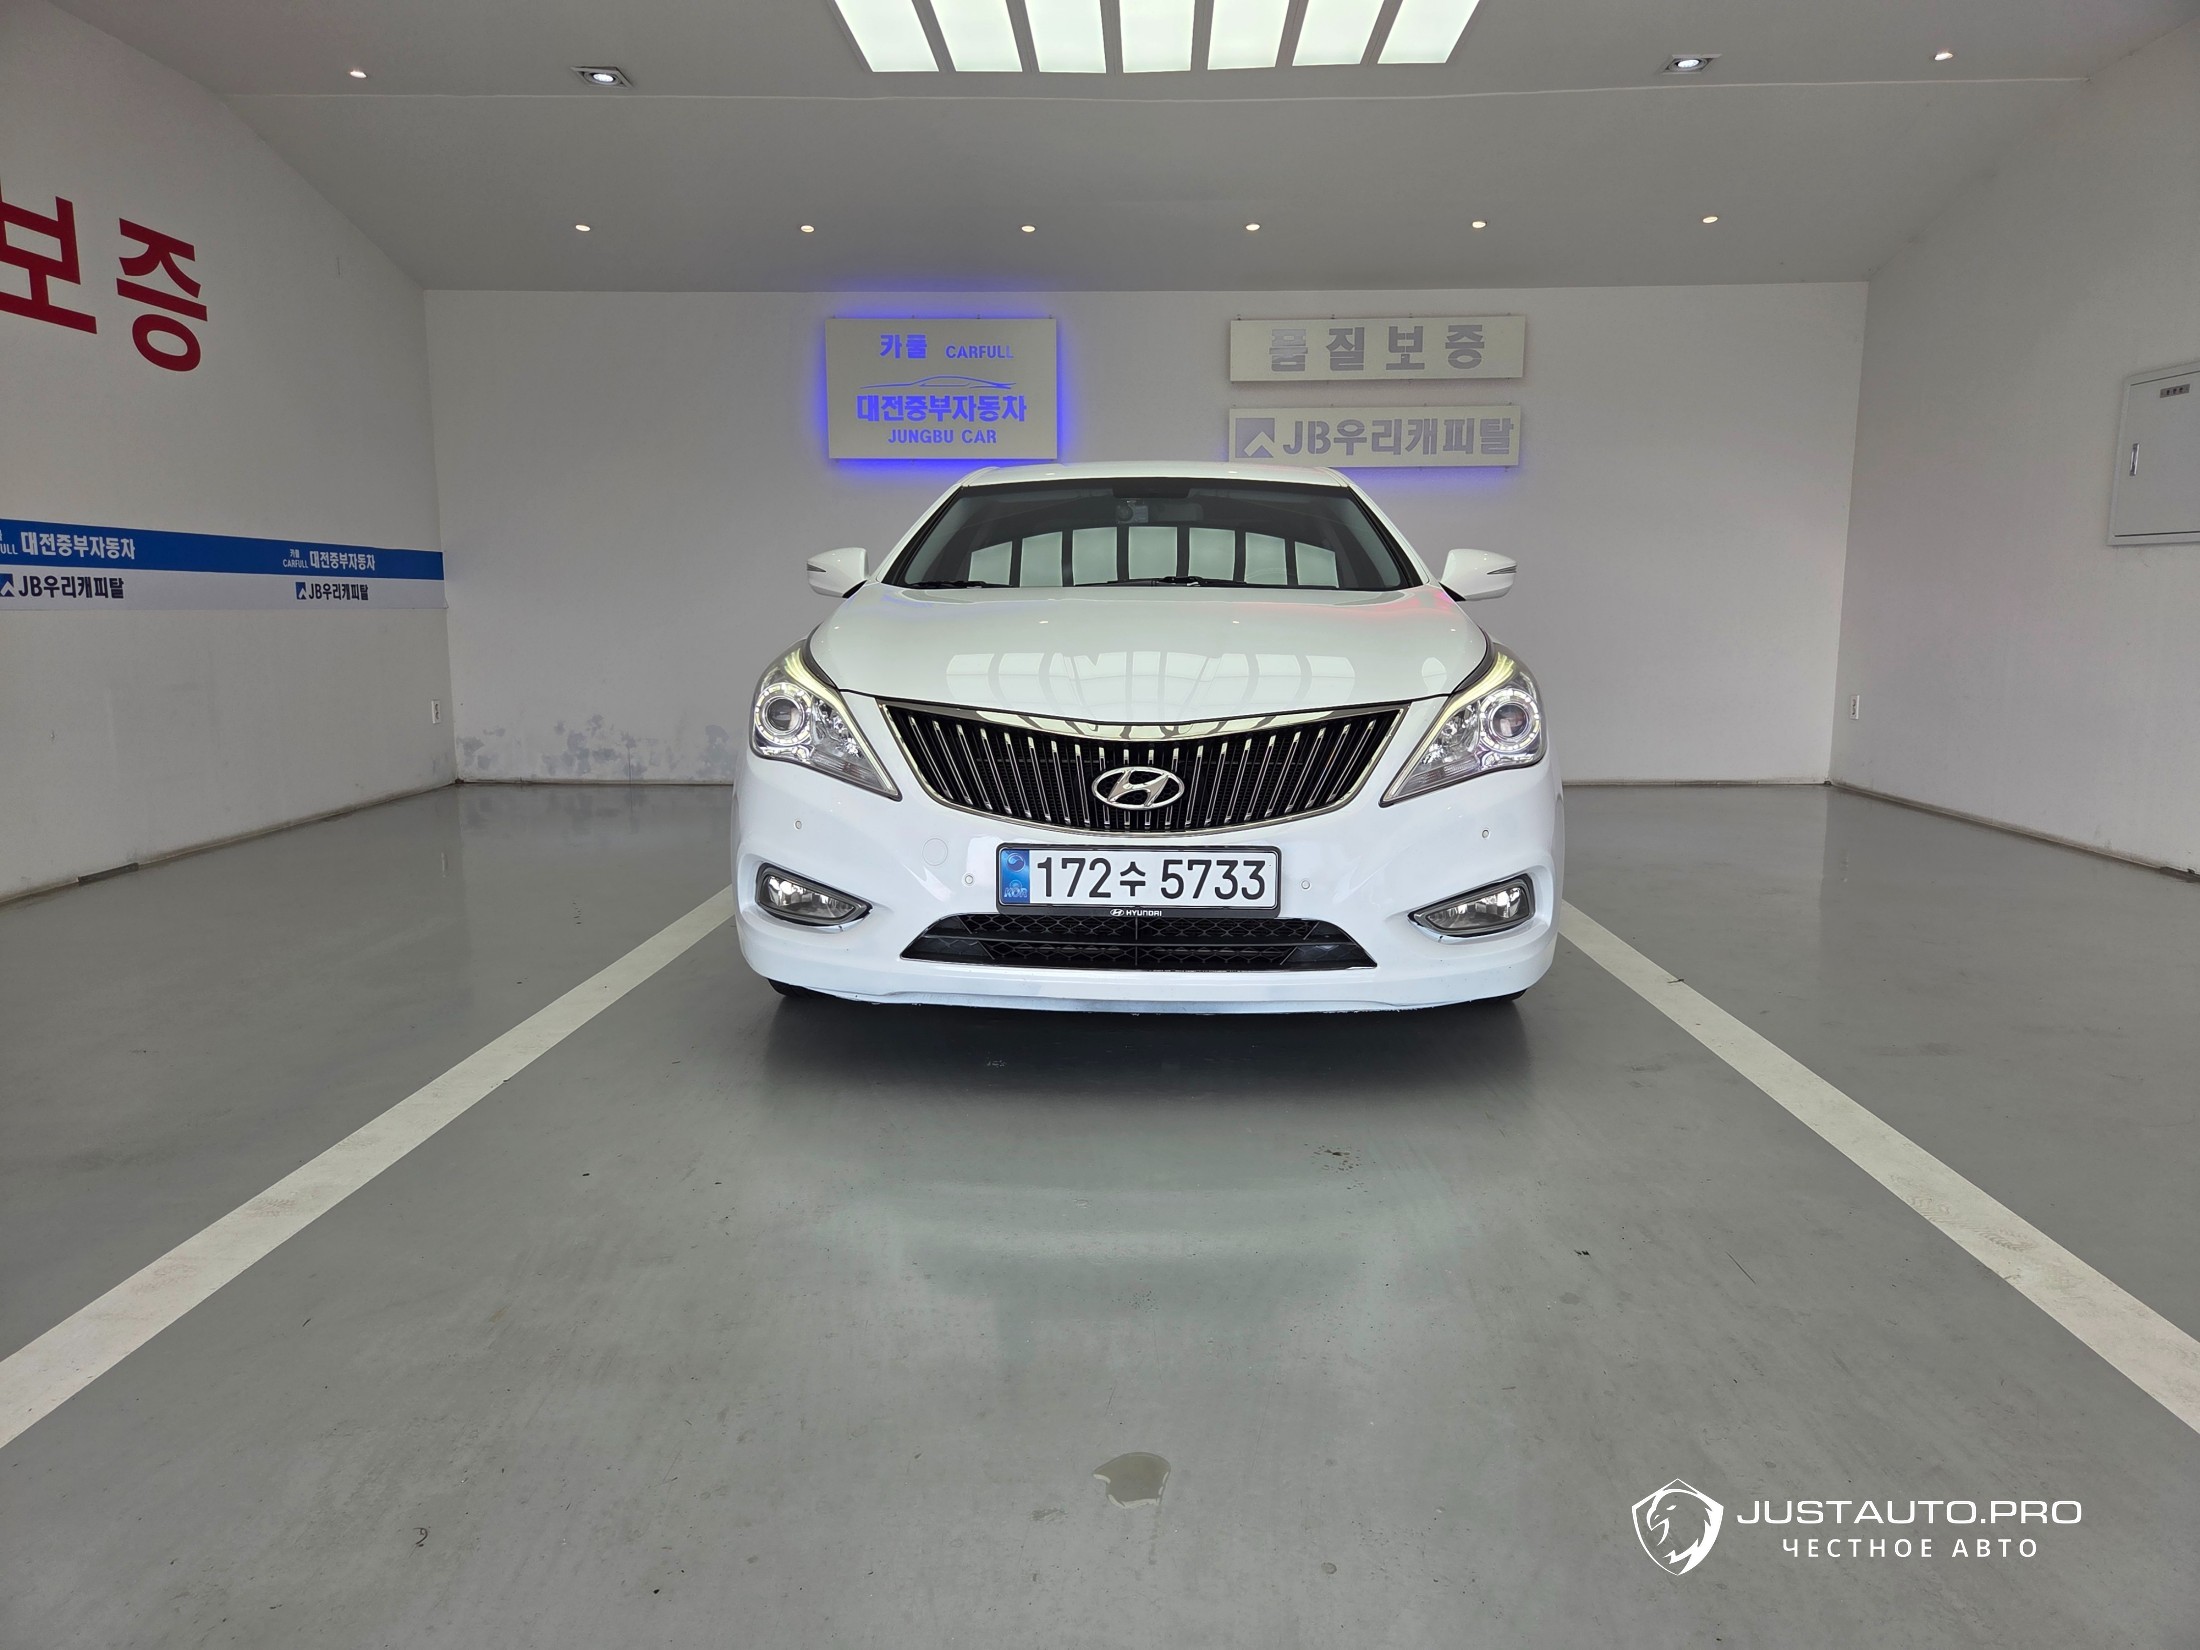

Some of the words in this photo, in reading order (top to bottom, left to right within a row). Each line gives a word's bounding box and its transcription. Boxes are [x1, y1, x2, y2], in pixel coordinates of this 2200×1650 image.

[945, 345, 1014, 359] CARFULL
[857, 395, 1027, 422] 대전중부자동차
[888, 429, 954, 444] JUNGBU
[961, 429, 997, 444] CAR
[1282, 417, 1514, 456] JB우리캐피탈
[20, 531, 136, 560] 대전중부자동차
[282, 559, 309, 569] CARFULL
[309, 550, 376, 571] 대전중부자동차
[18, 575, 124, 599] JB우리캐피탈
[308, 583, 369, 600] JB우리캐피탈
[1037, 856, 1146, 898] 172수
[1160, 859, 1266, 900] 5733
[1126, 909, 1162, 917] HYUNDAI
